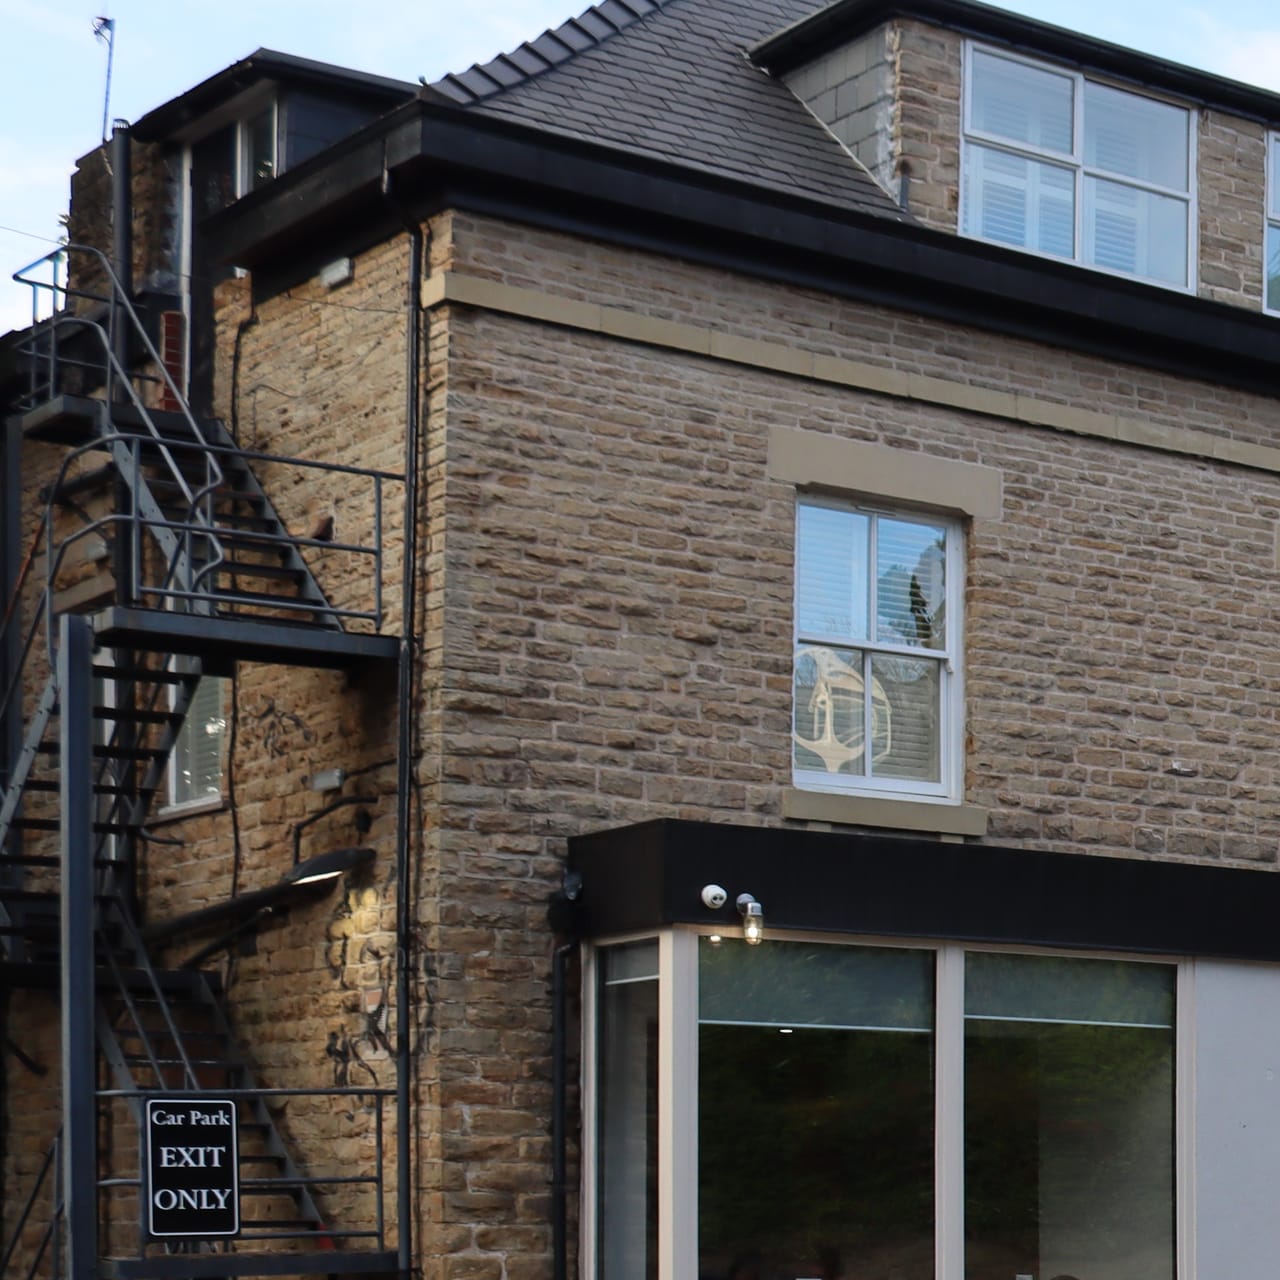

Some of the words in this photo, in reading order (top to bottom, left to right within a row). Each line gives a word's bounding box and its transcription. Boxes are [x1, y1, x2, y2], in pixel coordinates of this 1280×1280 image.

[152, 1110, 185, 1126] Car
[190, 1110, 230, 1126] Park
[160, 1146, 226, 1168] EXIT
[154, 1188, 232, 1210] ONLY
